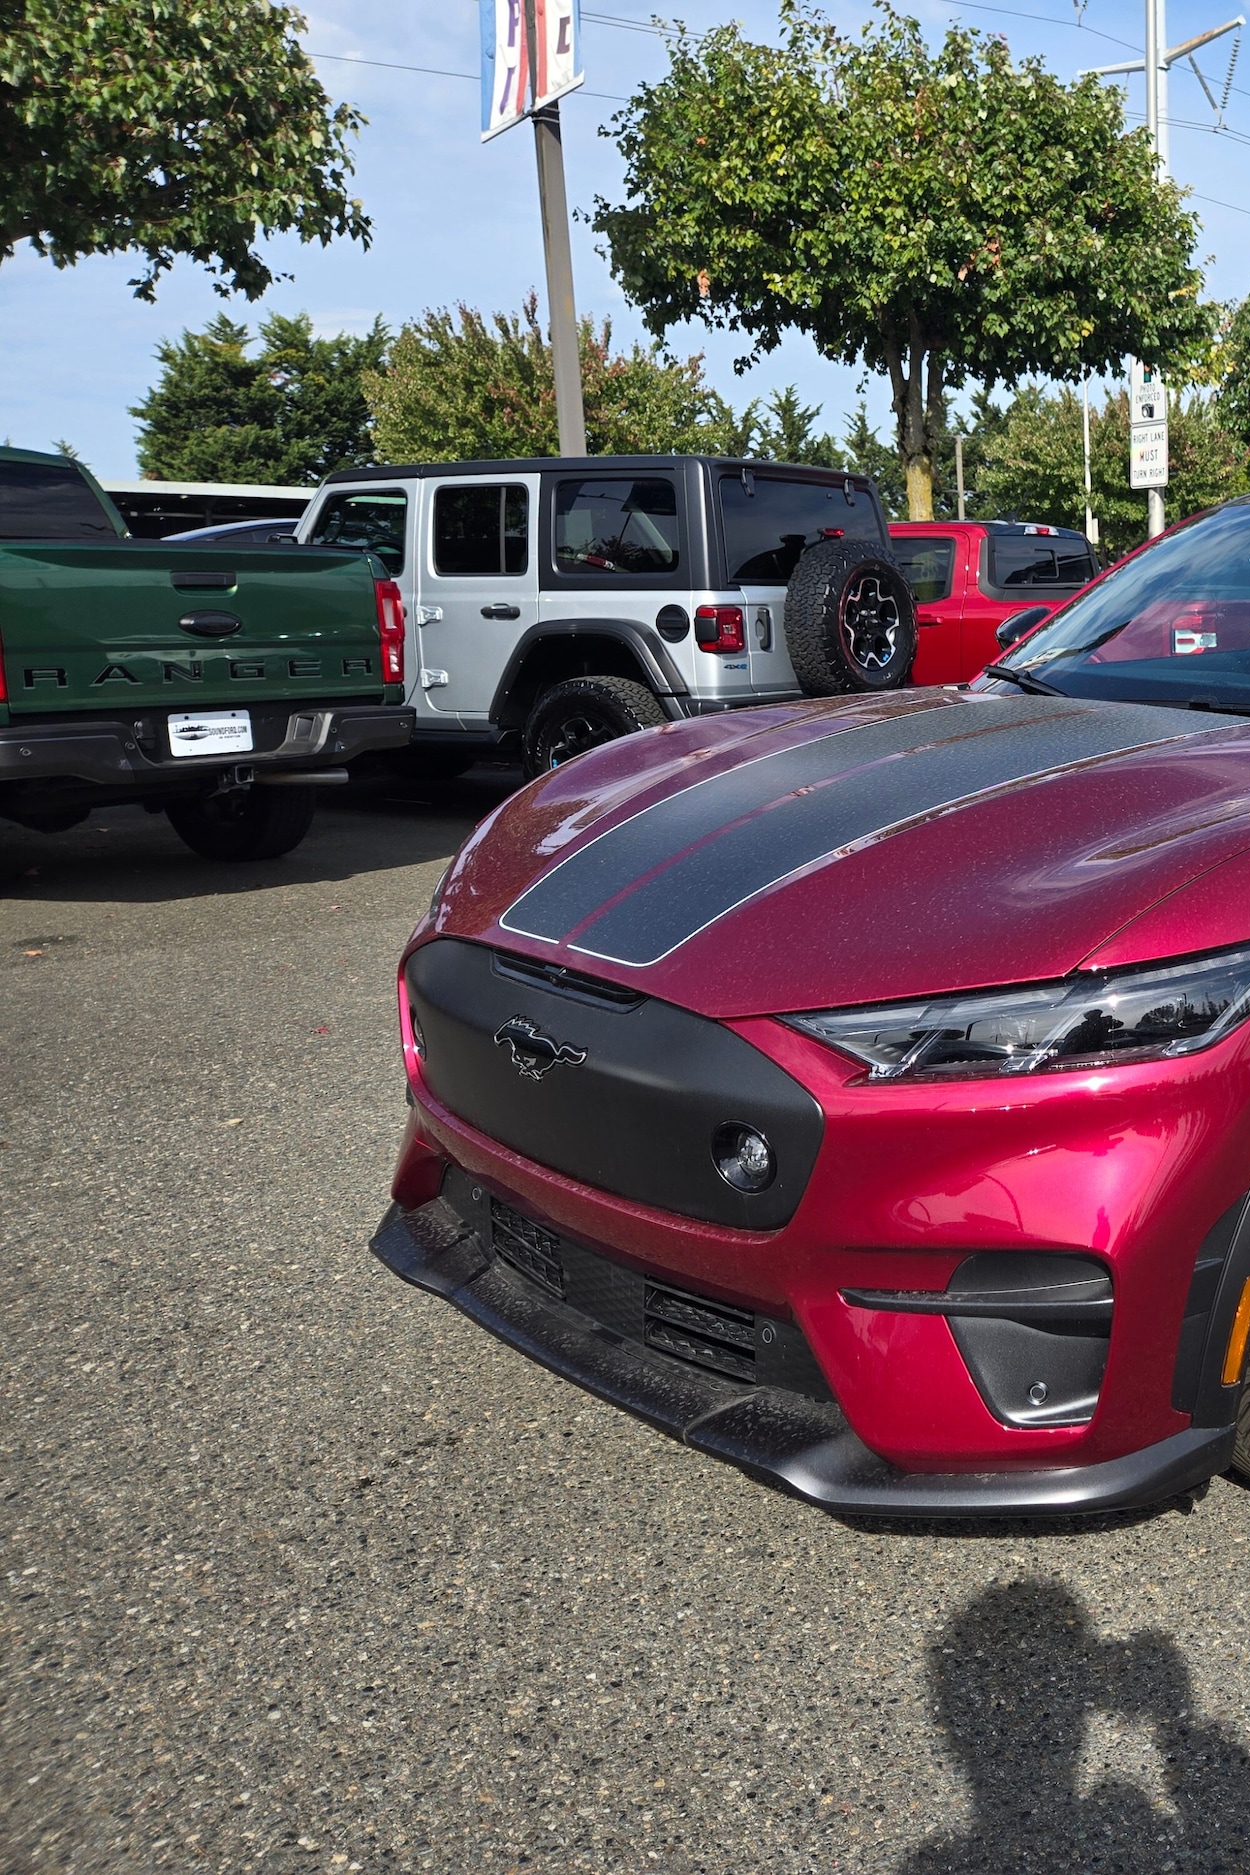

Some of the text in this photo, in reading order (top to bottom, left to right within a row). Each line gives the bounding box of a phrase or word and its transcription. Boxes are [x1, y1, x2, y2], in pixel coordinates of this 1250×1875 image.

[1140, 383, 1155, 393] PHOTO
[1136, 391, 1160, 403] ENFORCED
[1133, 431, 1165, 444] RIGHT LANE
[1139, 449, 1158, 462] MUST
[1133, 467, 1165, 480] TURN RIGHT
[22, 658, 374, 690] RANGER
